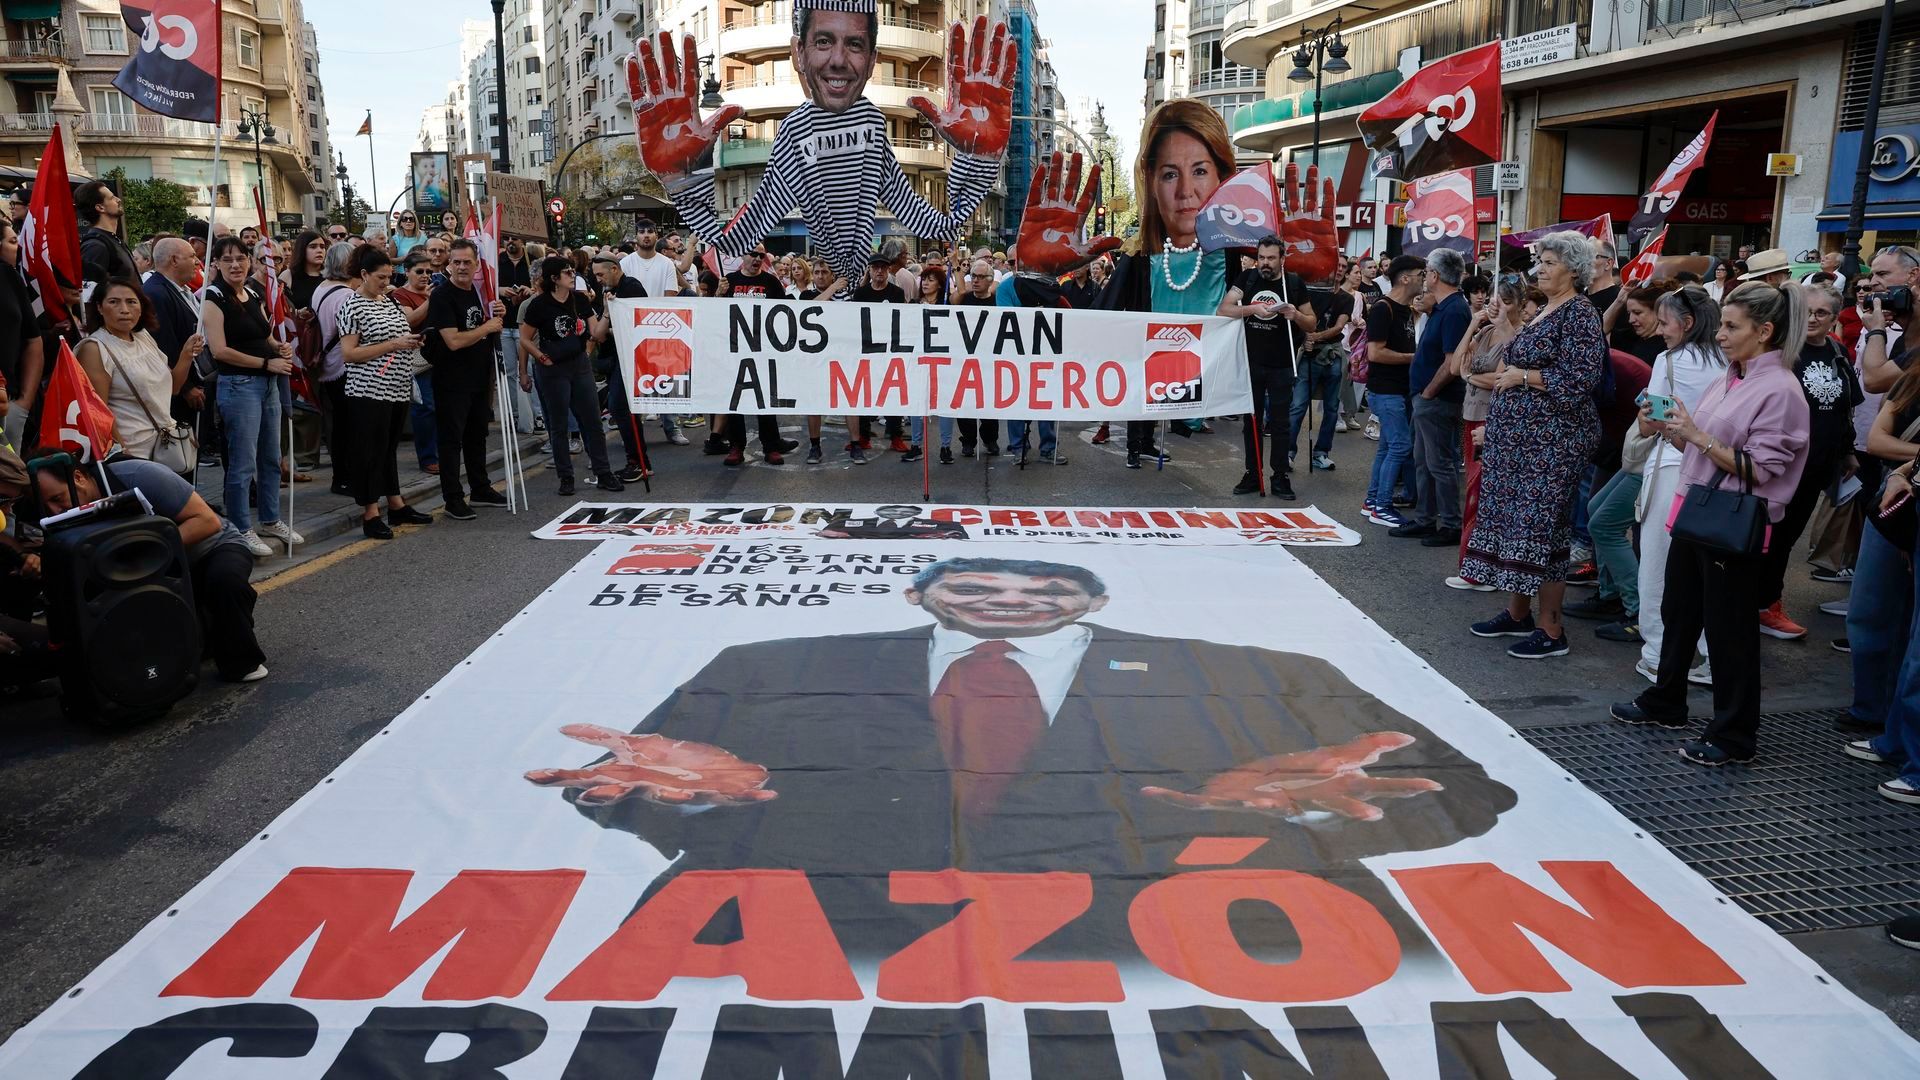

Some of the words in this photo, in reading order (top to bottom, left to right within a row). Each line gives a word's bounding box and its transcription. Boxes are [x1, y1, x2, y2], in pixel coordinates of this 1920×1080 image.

[1506, 39, 1518, 48] EN
[1521, 27, 1570, 44] ALQUILER
[1506, 60, 1521, 69] 638
[1523, 55, 1538, 65] 841
[1541, 51, 1558, 61] 468
[1810, 85, 1819, 98] 3
[542, 112, 553, 160] HOTEL
[803, 128, 874, 157] CIMINAL
[1871, 142, 1894, 165] La
[491, 175, 500, 190] LA
[500, 177, 517, 192] CARA
[1686, 202, 1728, 219] GAES
[729, 304, 829, 354] NOS
[860, 307, 1063, 355] LLEVAN
[638, 374, 690, 396] CGT
[729, 358, 797, 411] AL
[829, 356, 1127, 410] MATADERO
[1149, 379, 1201, 401] CGT
[930, 507, 1336, 529] CRIMINAL
[983, 528, 1020, 536] LES
[718, 544, 803, 554] LES
[711, 553, 938, 564] NOSTRES
[615, 566, 692, 575] CGT
[702, 563, 769, 575] DE
[787, 564, 921, 575] FANG
[600, 583, 698, 594] LES
[718, 582, 892, 595] SEUES
[588, 593, 662, 607] DE
[680, 591, 831, 607] SANG
[159, 837, 1747, 1003] MAZÓN
